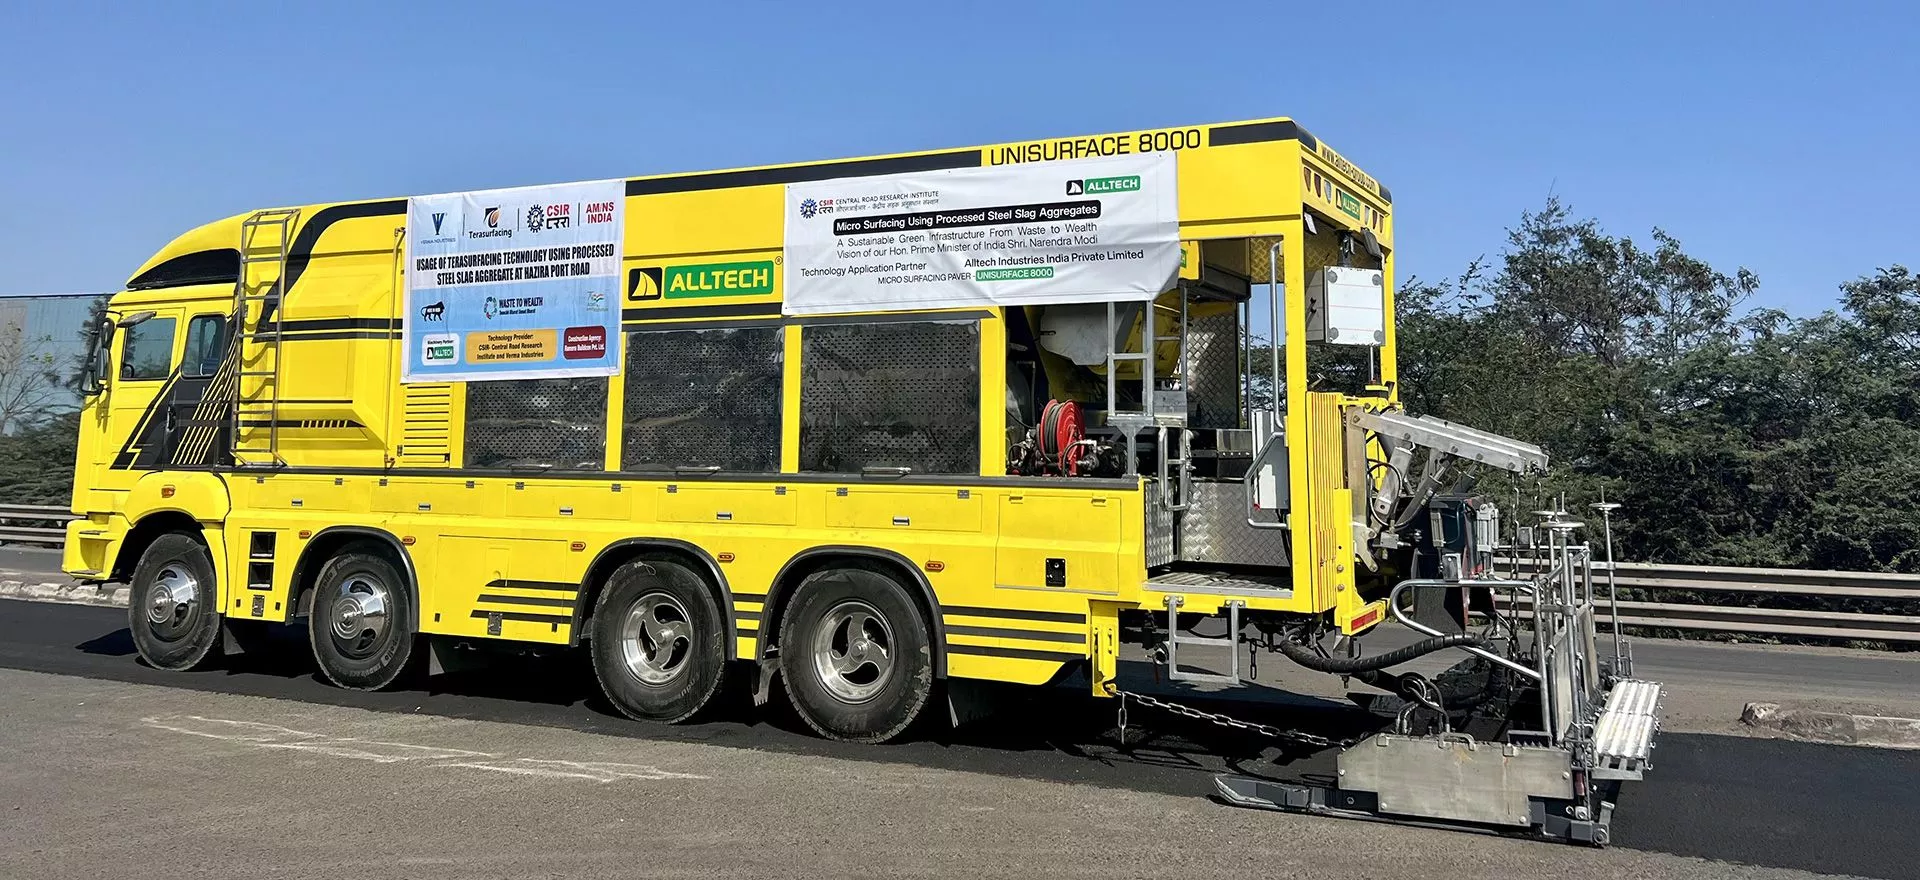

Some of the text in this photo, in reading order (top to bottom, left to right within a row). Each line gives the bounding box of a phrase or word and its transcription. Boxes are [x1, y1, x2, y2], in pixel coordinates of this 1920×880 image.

[991, 129, 1201, 166] UNISURFACE 8000
[1088, 179, 1138, 191] ALLTECH
[880, 193, 908, 201] RESEARCH
[547, 204, 570, 216] CSIR
[588, 213, 612, 223] INDIA
[837, 205, 1098, 231] Micro Surfacing Using Processed Steel Slag Aggregates
[469, 229, 512, 239] Terasurfacing
[837, 222, 1097, 247] A Sustainable Green Infrastructure From Waste to Wealth
[837, 235, 1098, 258] Vision of our Hon. Prime Minister of India Shri. Narendra Modi
[417, 244, 614, 271] USAGE OF TERASURFACING TECHNOLOGY USING PROCESSED
[964, 249, 1144, 267] Alltech Industries India Private Limited
[437, 262, 590, 285] STEEL SLAG AGGREGATE AT HAZIRA PORT ROAD
[801, 262, 927, 277] Technology Application Partner
[878, 276, 902, 284] MICRO
[904, 273, 946, 283] SURFACING
[948, 272, 971, 281] PAVER
[977, 270, 1029, 280] UNISURFACE
[1030, 268, 1052, 277] 8000
[670, 268, 768, 292] ALLTECH
[499, 297, 543, 308] WASTE TO WEALTH
[434, 349, 453, 357] ALLTECH
